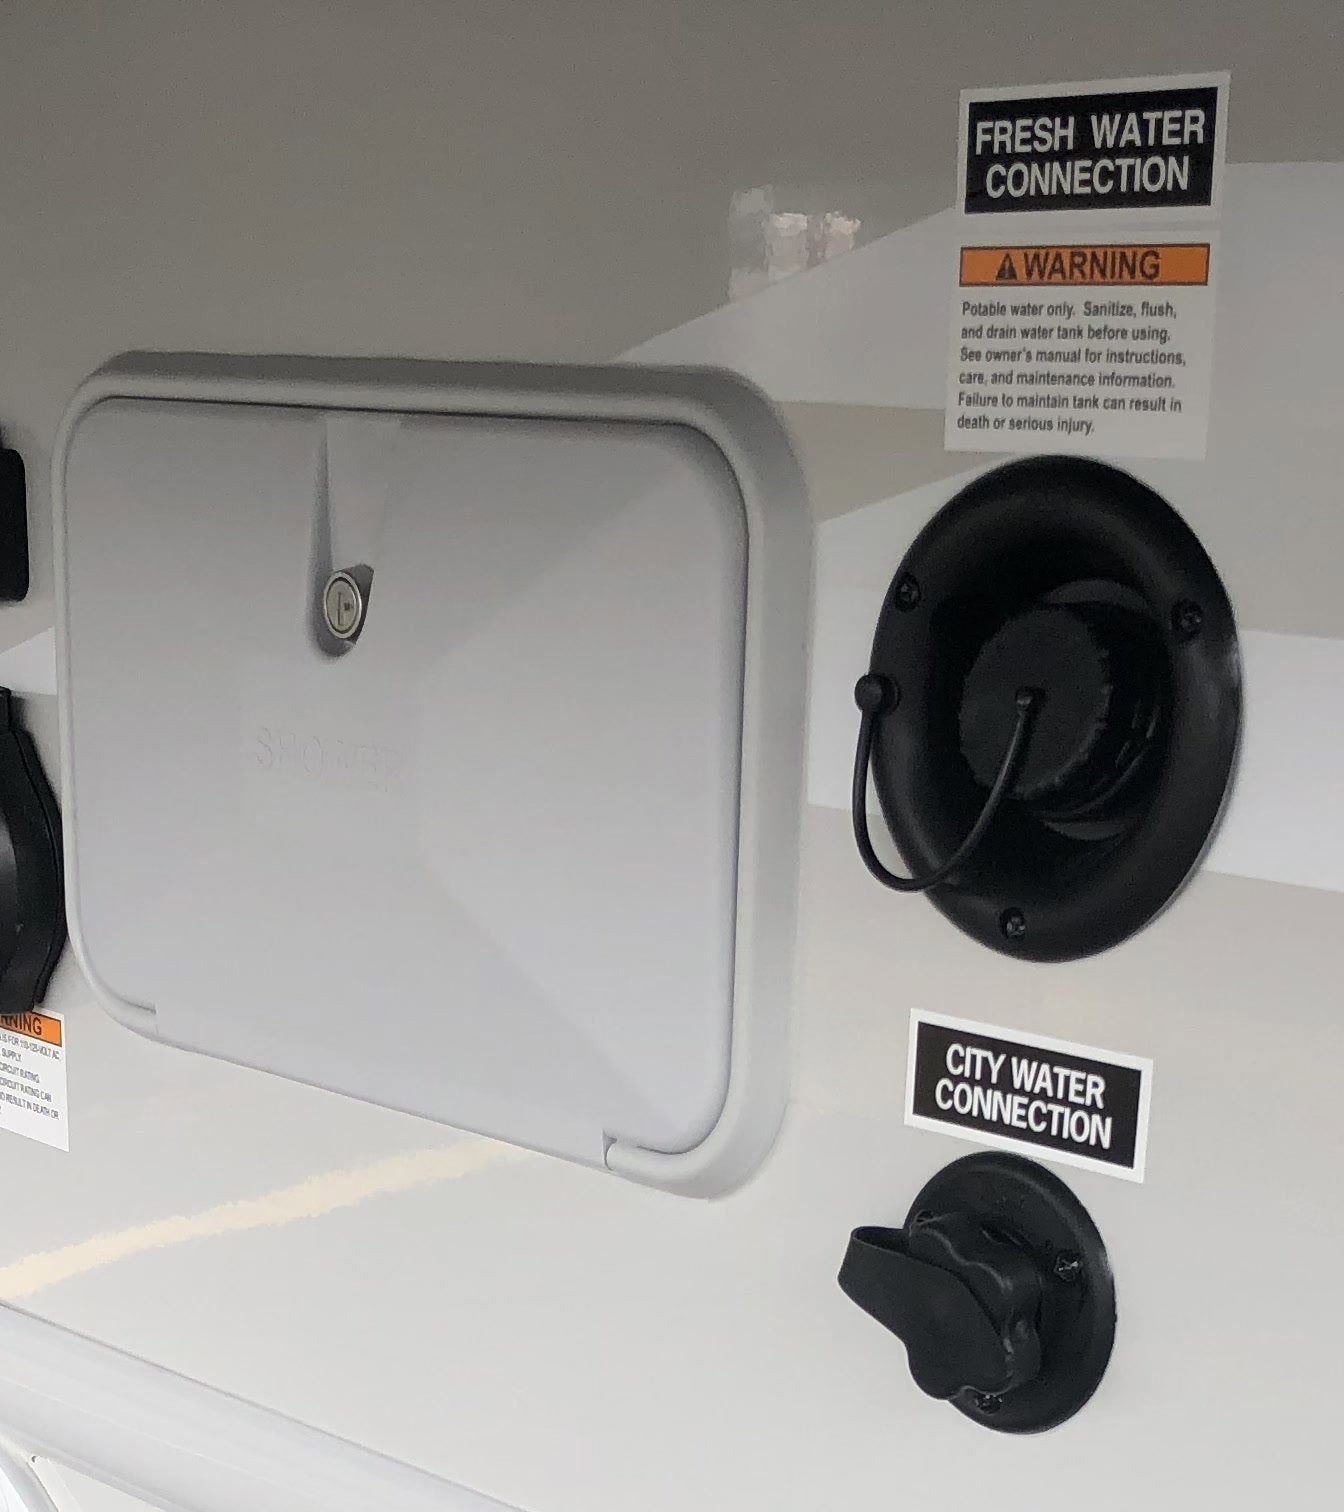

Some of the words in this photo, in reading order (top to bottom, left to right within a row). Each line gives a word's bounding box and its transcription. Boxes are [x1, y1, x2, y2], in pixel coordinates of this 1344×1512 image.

[976, 116, 1075, 155] FRESH
[1090, 109, 1206, 149] WATER
[985, 155, 1190, 198] CONNECTION
[1023, 251, 1161, 281] WARNING
[962, 301, 1007, 317] Potable
[1010, 303, 1045, 317] water
[1047, 302, 1076, 320] only.
[1083, 300, 1137, 318] Sanitize,
[1141, 301, 1177, 319] flush,
[961, 324, 984, 339] and
[986, 324, 1017, 339] drain
[1020, 325, 1055, 340] water
[1057, 325, 1084, 340] tank
[1087, 325, 1128, 340] before
[1131, 326, 1171, 345] using.
[961, 346, 982, 362] See
[985, 346, 1033, 363] owner's
[1036, 348, 1082, 363] manual
[1085, 348, 1103, 363] for
[1106, 349, 1186, 367] instructions,
[959, 372, 989, 387] care,
[991, 369, 1014, 385] and
[1017, 371, 1096, 387] maintenance
[1098, 371, 1176, 388] information.
[958, 391, 999, 407] Failure
[1001, 392, 1014, 408] to
[1017, 393, 1070, 409] maintain
[1072, 394, 1100, 410] tank
[1102, 398, 1126, 411] can
[1129, 396, 1166, 412] result
[1169, 397, 1183, 413] in
[957, 413, 991, 430] death
[993, 417, 1007, 430] or
[1009, 416, 1054, 431] serious
[1056, 417, 1095, 437] injury.
[946, 1043, 1007, 1085] CITY
[1010, 1055, 1107, 1110] WATER
[935, 1077, 1113, 1150] CONNECTION
